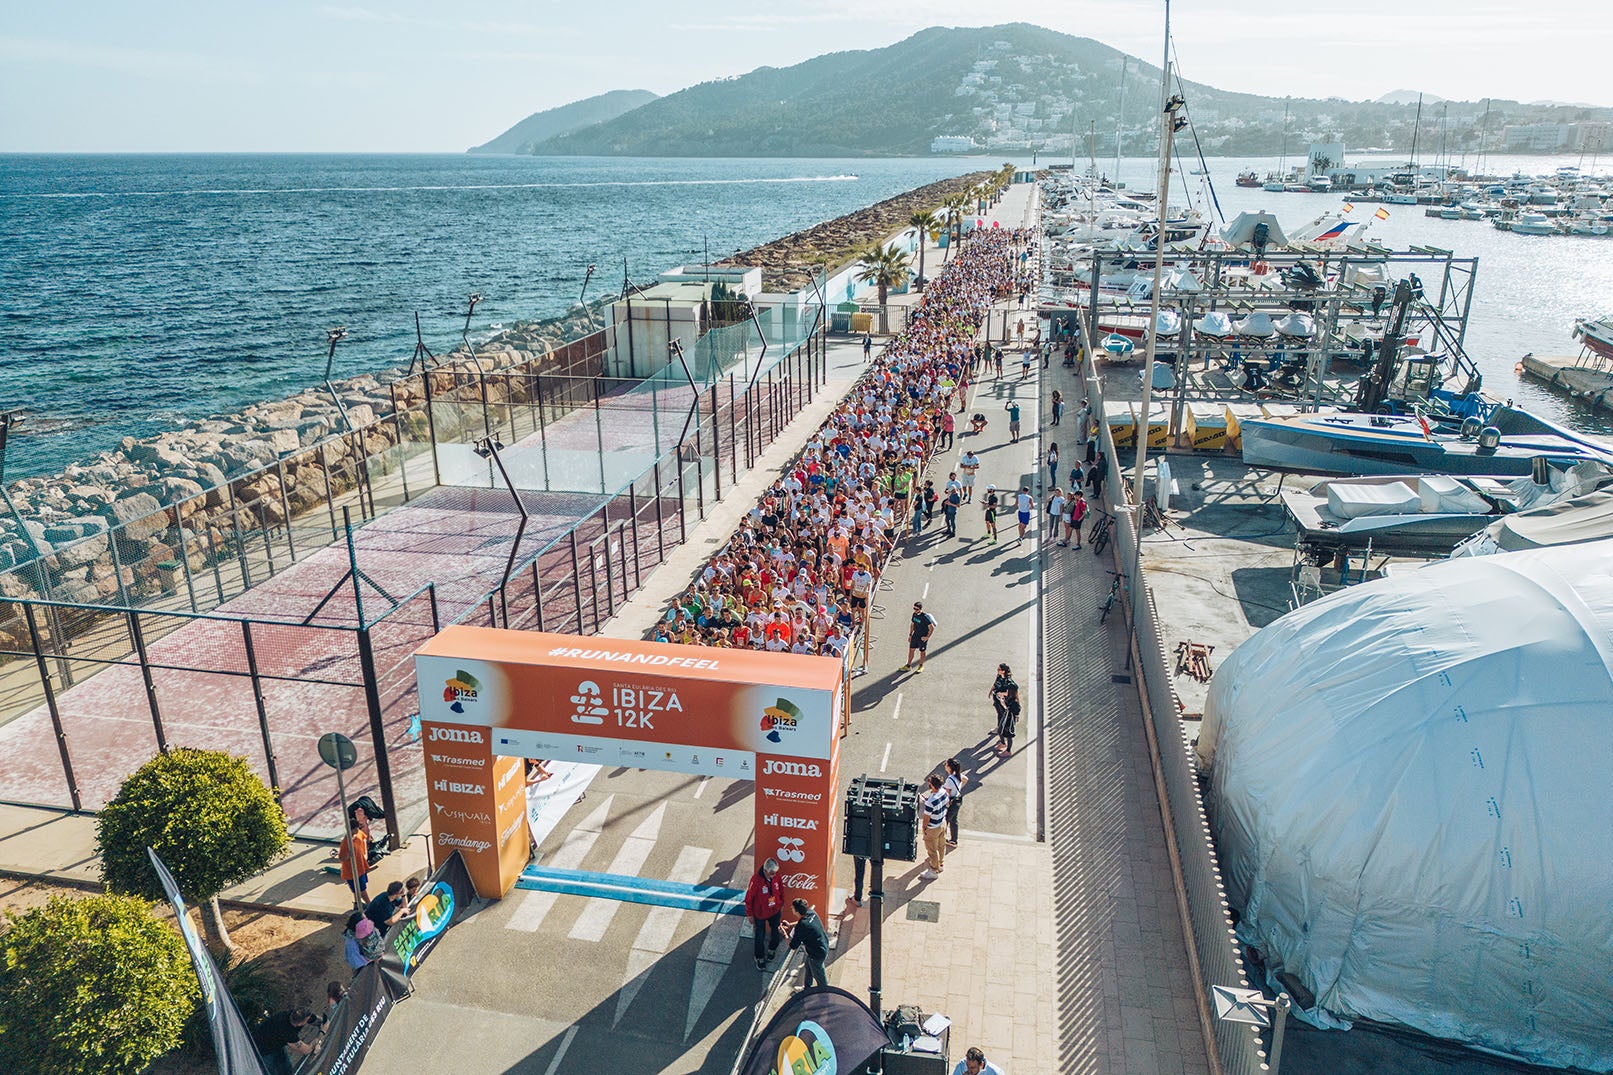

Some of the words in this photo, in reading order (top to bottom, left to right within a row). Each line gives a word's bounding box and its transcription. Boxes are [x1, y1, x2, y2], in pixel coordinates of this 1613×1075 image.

[548, 647, 721, 671] #RUNANDFEEL
[449, 685, 478, 698] Ibiza
[613, 687, 683, 713] IBIZA
[614, 709, 655, 730] 12K
[766, 714, 797, 726] Ibiza
[442, 755, 486, 767] Trasmed
[775, 788, 822, 801] Trasmed
[438, 832, 492, 853] Fandango
[393, 919, 417, 950] SANTA
[376, 995, 386, 1013] RIU
[358, 1013, 369, 1028] DE
